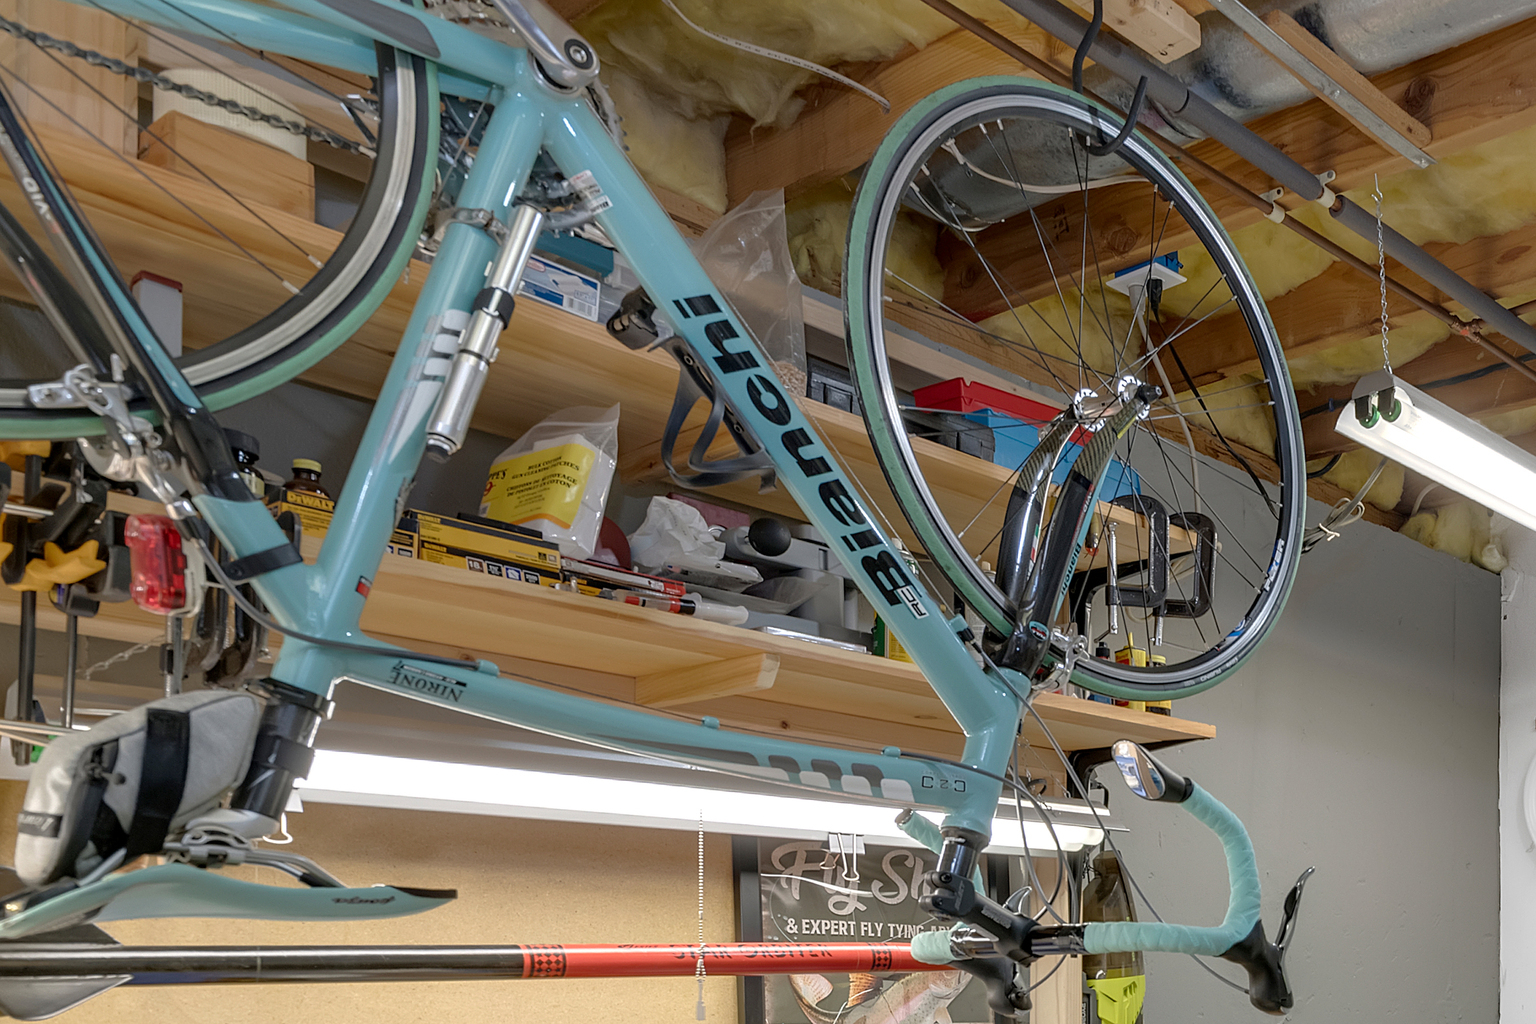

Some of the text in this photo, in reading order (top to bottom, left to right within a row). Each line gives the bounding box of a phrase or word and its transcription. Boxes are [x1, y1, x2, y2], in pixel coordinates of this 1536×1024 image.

[672, 293, 923, 607] Bianchi
[1061, 542, 1083, 596] Bianchi
[390, 671, 464, 702] NIRONE
[771, 841, 867, 916] Fly
[786, 918, 798, 933] &
[801, 918, 856, 937] EXPERT
[860, 923, 884, 938] FLY
